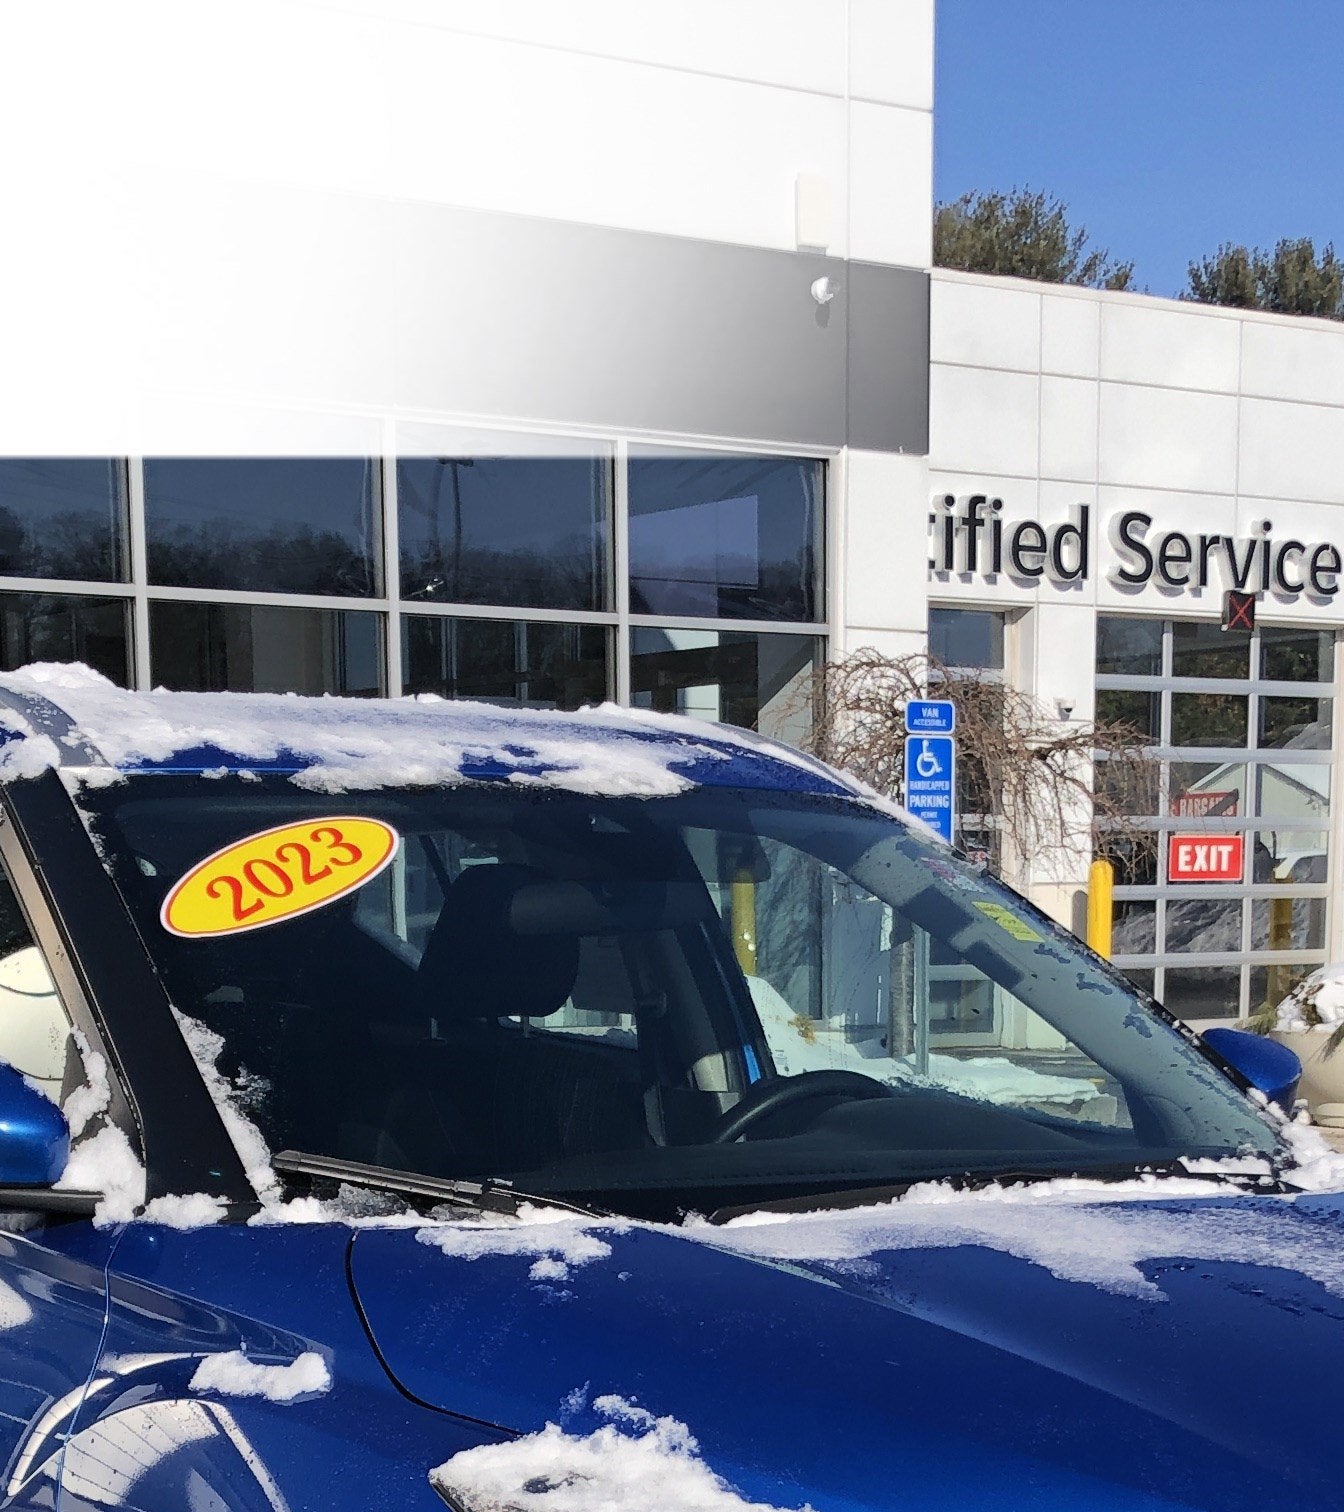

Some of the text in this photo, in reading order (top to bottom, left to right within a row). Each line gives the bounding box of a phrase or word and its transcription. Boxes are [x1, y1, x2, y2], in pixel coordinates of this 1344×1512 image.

[1117, 512, 1343, 595] Service
[921, 707, 940, 718] VAN
[909, 780, 950, 791] HANDICAPPED
[909, 794, 950, 808] PARKING
[1178, 844, 1234, 872] EXIT
[206, 827, 363, 922] 2023
